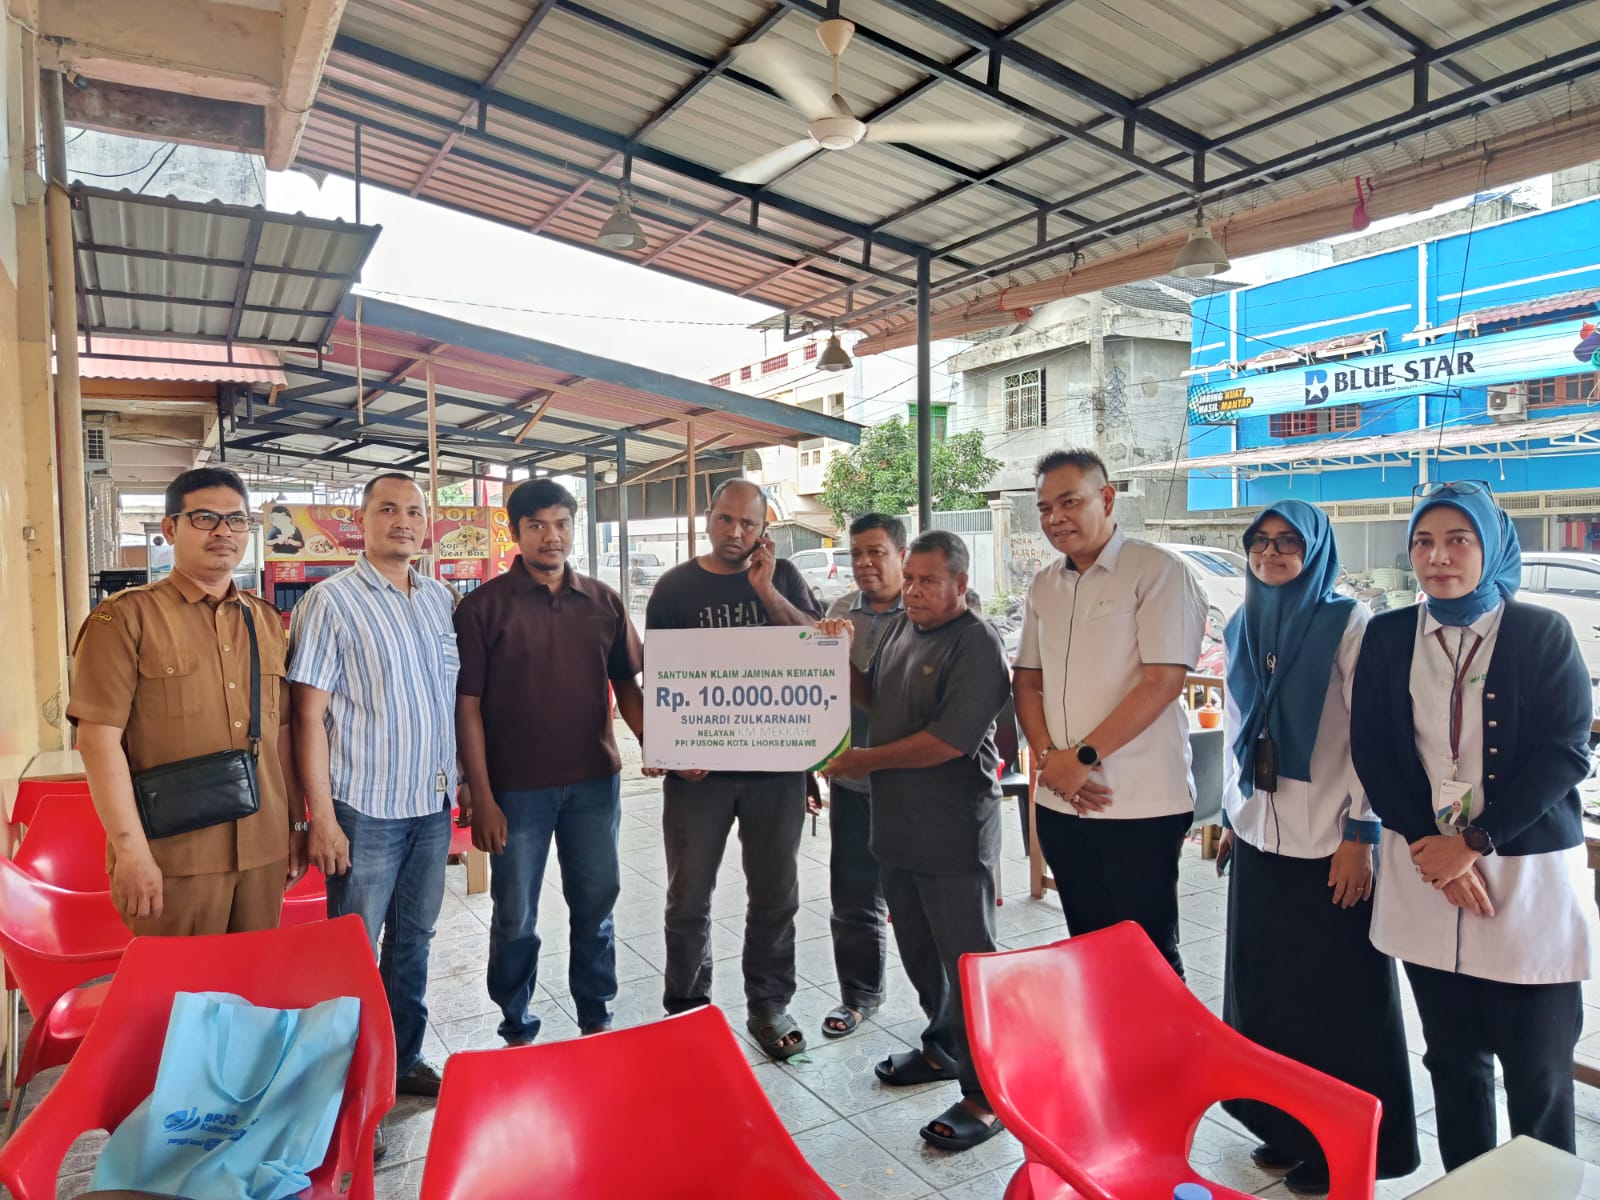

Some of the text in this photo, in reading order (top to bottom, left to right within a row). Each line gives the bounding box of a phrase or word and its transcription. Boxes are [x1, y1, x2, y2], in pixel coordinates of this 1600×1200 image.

[1334, 351, 1476, 393] BLUE STAR
[1199, 388, 1246, 405] JARING KUAT
[1198, 397, 1253, 415] HASIL MANTAP
[440, 542, 459, 551] Sop
[467, 549, 485, 557] Box
[657, 668, 836, 680] SANTUNAN KLAIM JAMINAN KEMATIAN
[656, 684, 838, 713] Rp. 10.000.000,-
[681, 714, 811, 725] SUHARDI ZULKARNAINI
[697, 726, 809, 737] NELAYAN KM MEKKAH
[675, 738, 817, 747] PPI PUSONG KOTA LHOKSEUMAWE
[203, 1112, 240, 1127] BPJS
